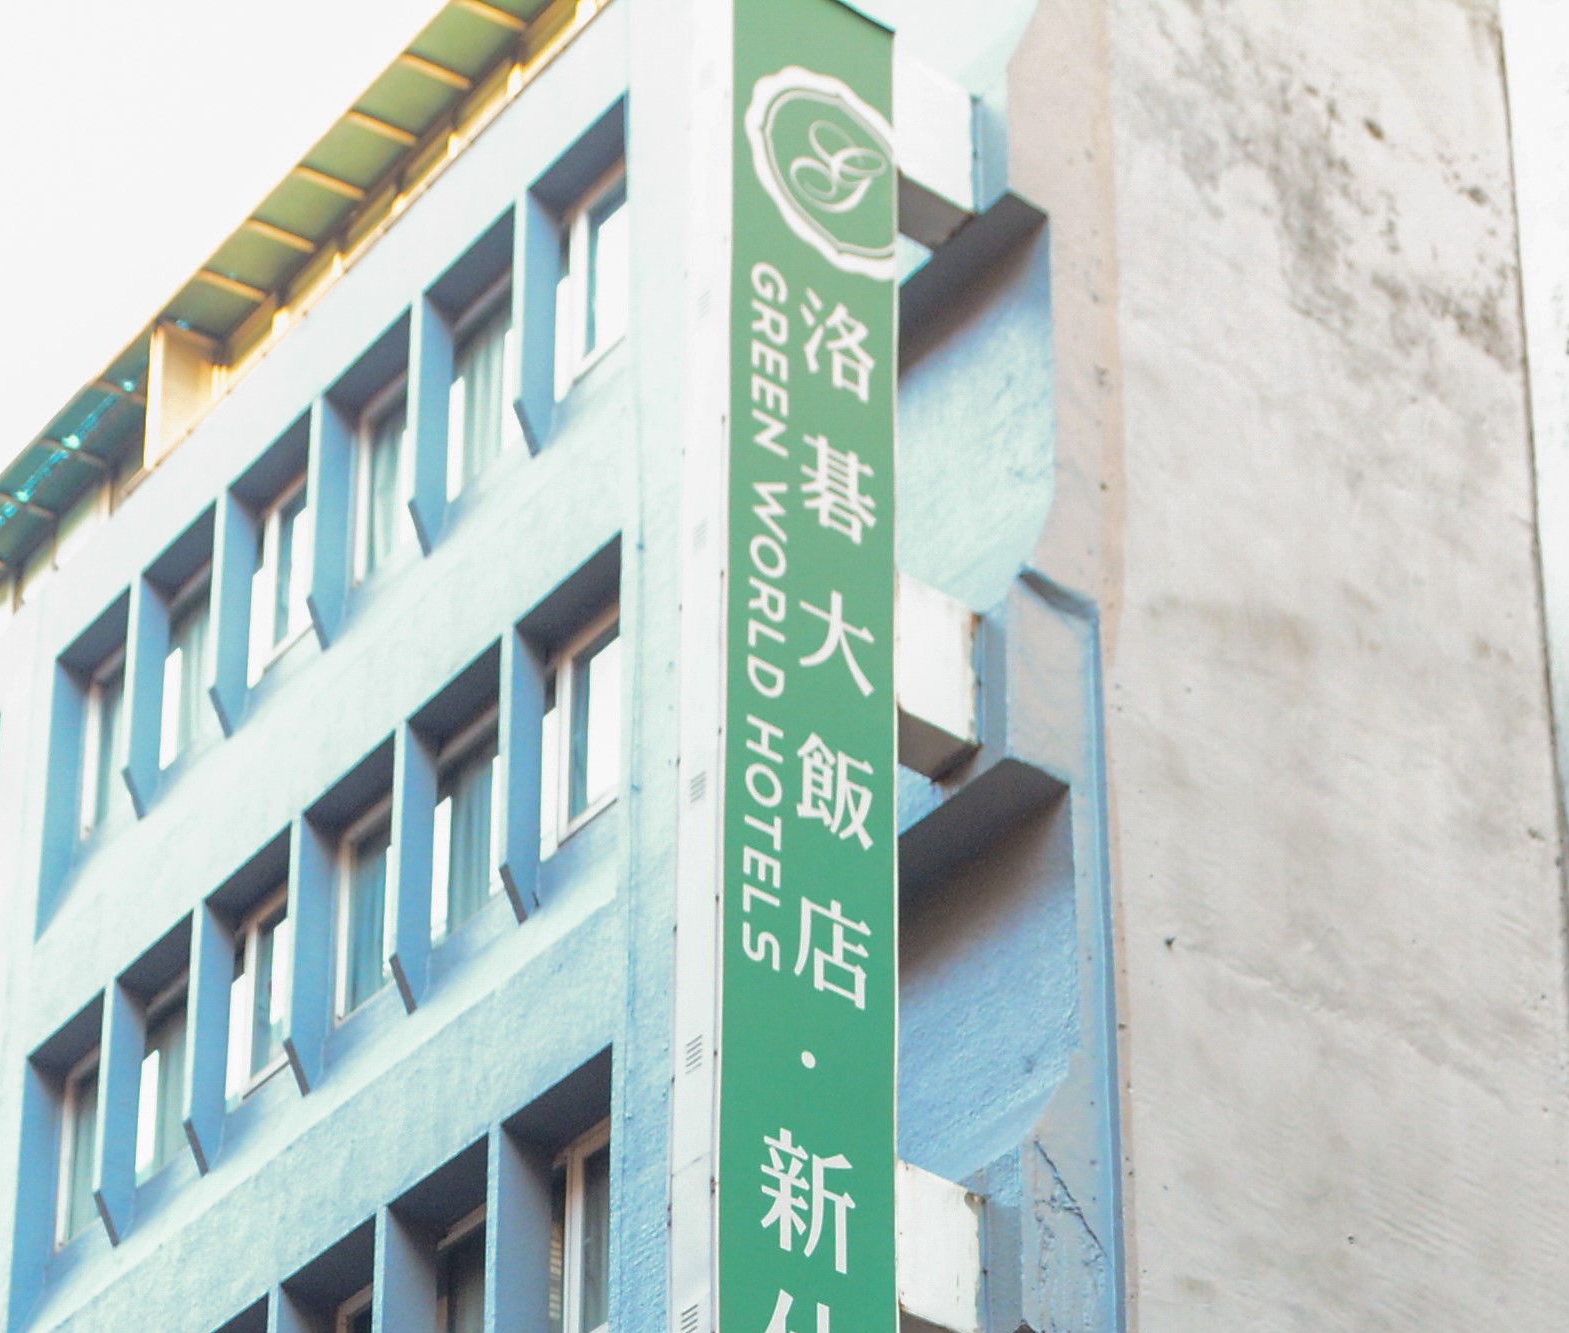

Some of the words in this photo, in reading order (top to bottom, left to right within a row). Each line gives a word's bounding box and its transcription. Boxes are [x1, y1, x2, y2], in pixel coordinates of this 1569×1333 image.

[751, 262, 789, 457] GREEN
[747, 481, 788, 698] WORLD
[742, 715, 783, 970] HOTELS
